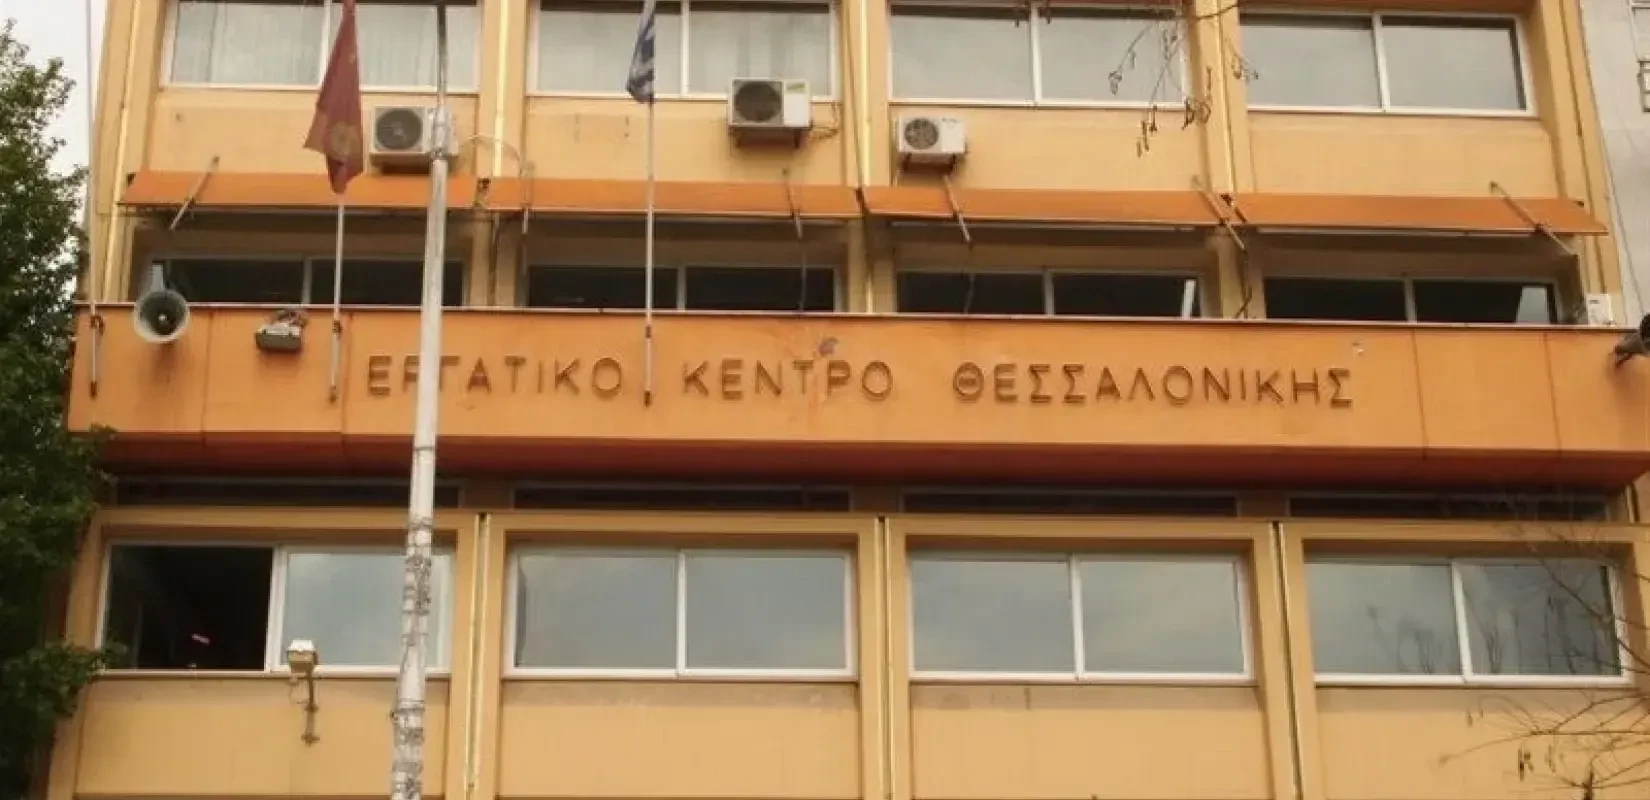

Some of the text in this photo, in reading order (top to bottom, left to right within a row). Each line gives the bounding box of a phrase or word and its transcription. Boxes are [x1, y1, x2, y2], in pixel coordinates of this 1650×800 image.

[366, 355, 1353, 408] ΕΡΓΑΤΙΚΟ ΚΕΝΤΡΟ ΘΕΣΣΑΛΟΝΙΚΗΣ
